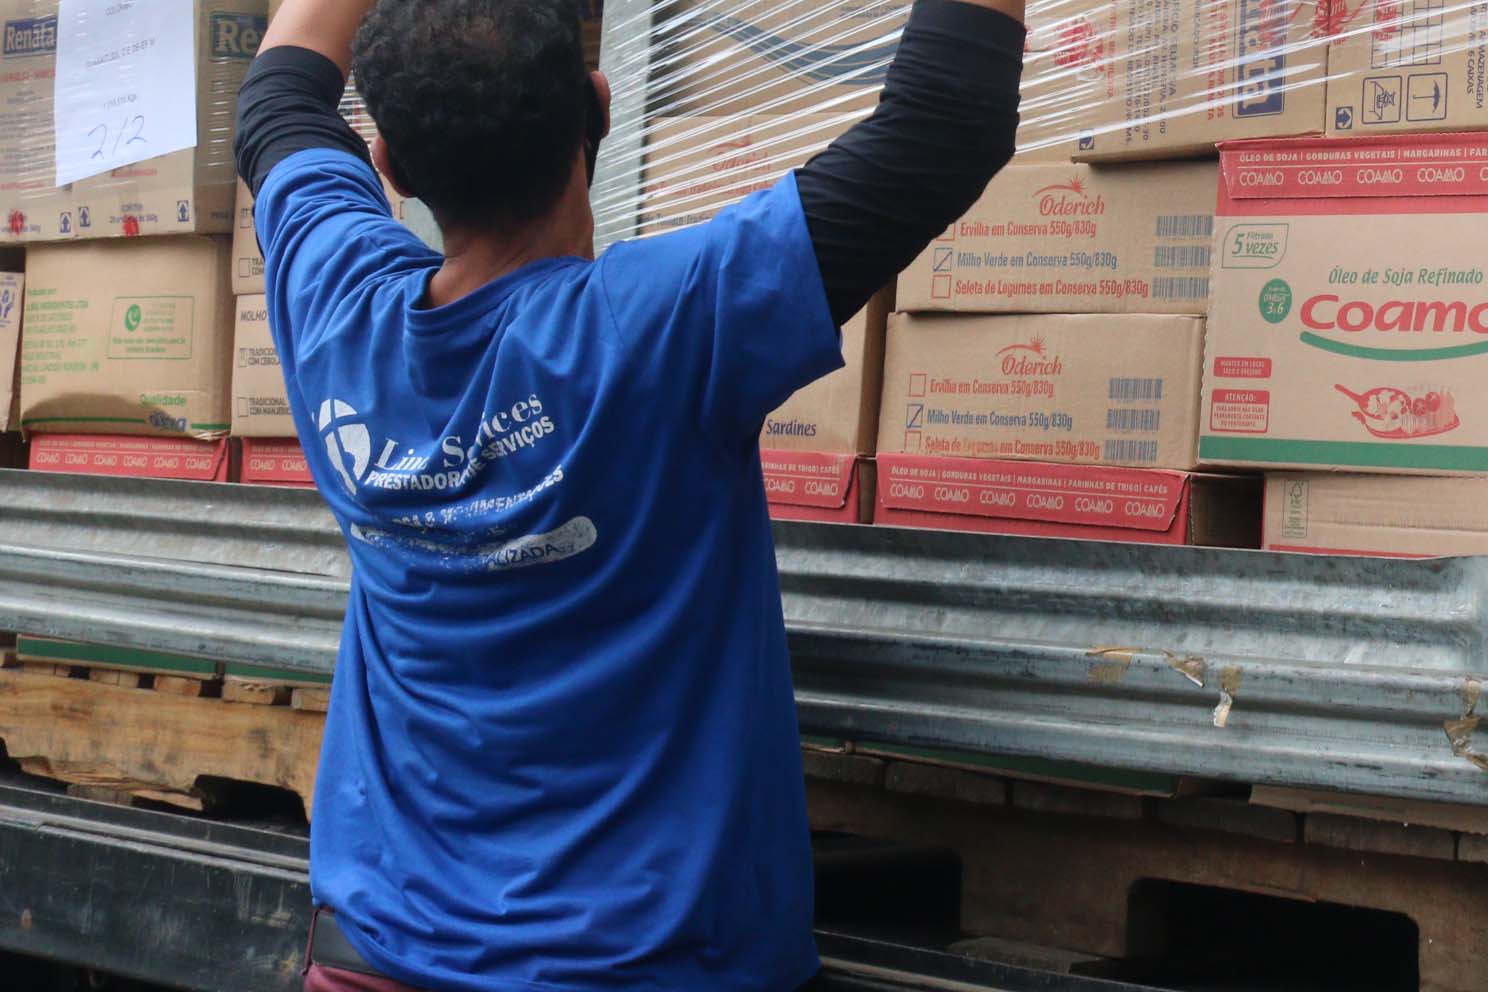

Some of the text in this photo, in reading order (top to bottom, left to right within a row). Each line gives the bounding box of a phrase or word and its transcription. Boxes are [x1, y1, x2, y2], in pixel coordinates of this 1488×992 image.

[1239, 171, 1284, 186] COAMO
[1298, 170, 1343, 185] COAMO
[1357, 169, 1403, 184] COAMO
[1417, 168, 1464, 183] COAMO
[1039, 192, 1105, 216] Oderich
[960, 220, 1096, 238] Ervilha em Conserva 550g/830g
[1232, 234, 1279, 255] 5 vezes
[957, 252, 1117, 269] Milho Verde em Conserva 550g/830g
[1328, 265, 1484, 288] Óleo de Soja Refinado
[955, 280, 1149, 298] Seleta de Legumes em Conserva 550g/830g
[1001, 354, 1063, 376] Oderich
[930, 379, 1054, 398] Ervilha em Conserva 550g/830g
[140, 393, 187, 407] Qualidade
[927, 409, 949, 425] Milho
[951, 410, 974, 425] Verde
[975, 413, 987, 425] em
[989, 412, 1027, 426] Conserva
[766, 419, 817, 438] Sardines
[925, 436, 950, 451] Seleta
[1014, 440, 1053, 456] Conserva
[804, 480, 839, 497] COAMO
[890, 484, 1165, 518] COAMO COAMO COAMO COAMO COAMO COAMO
